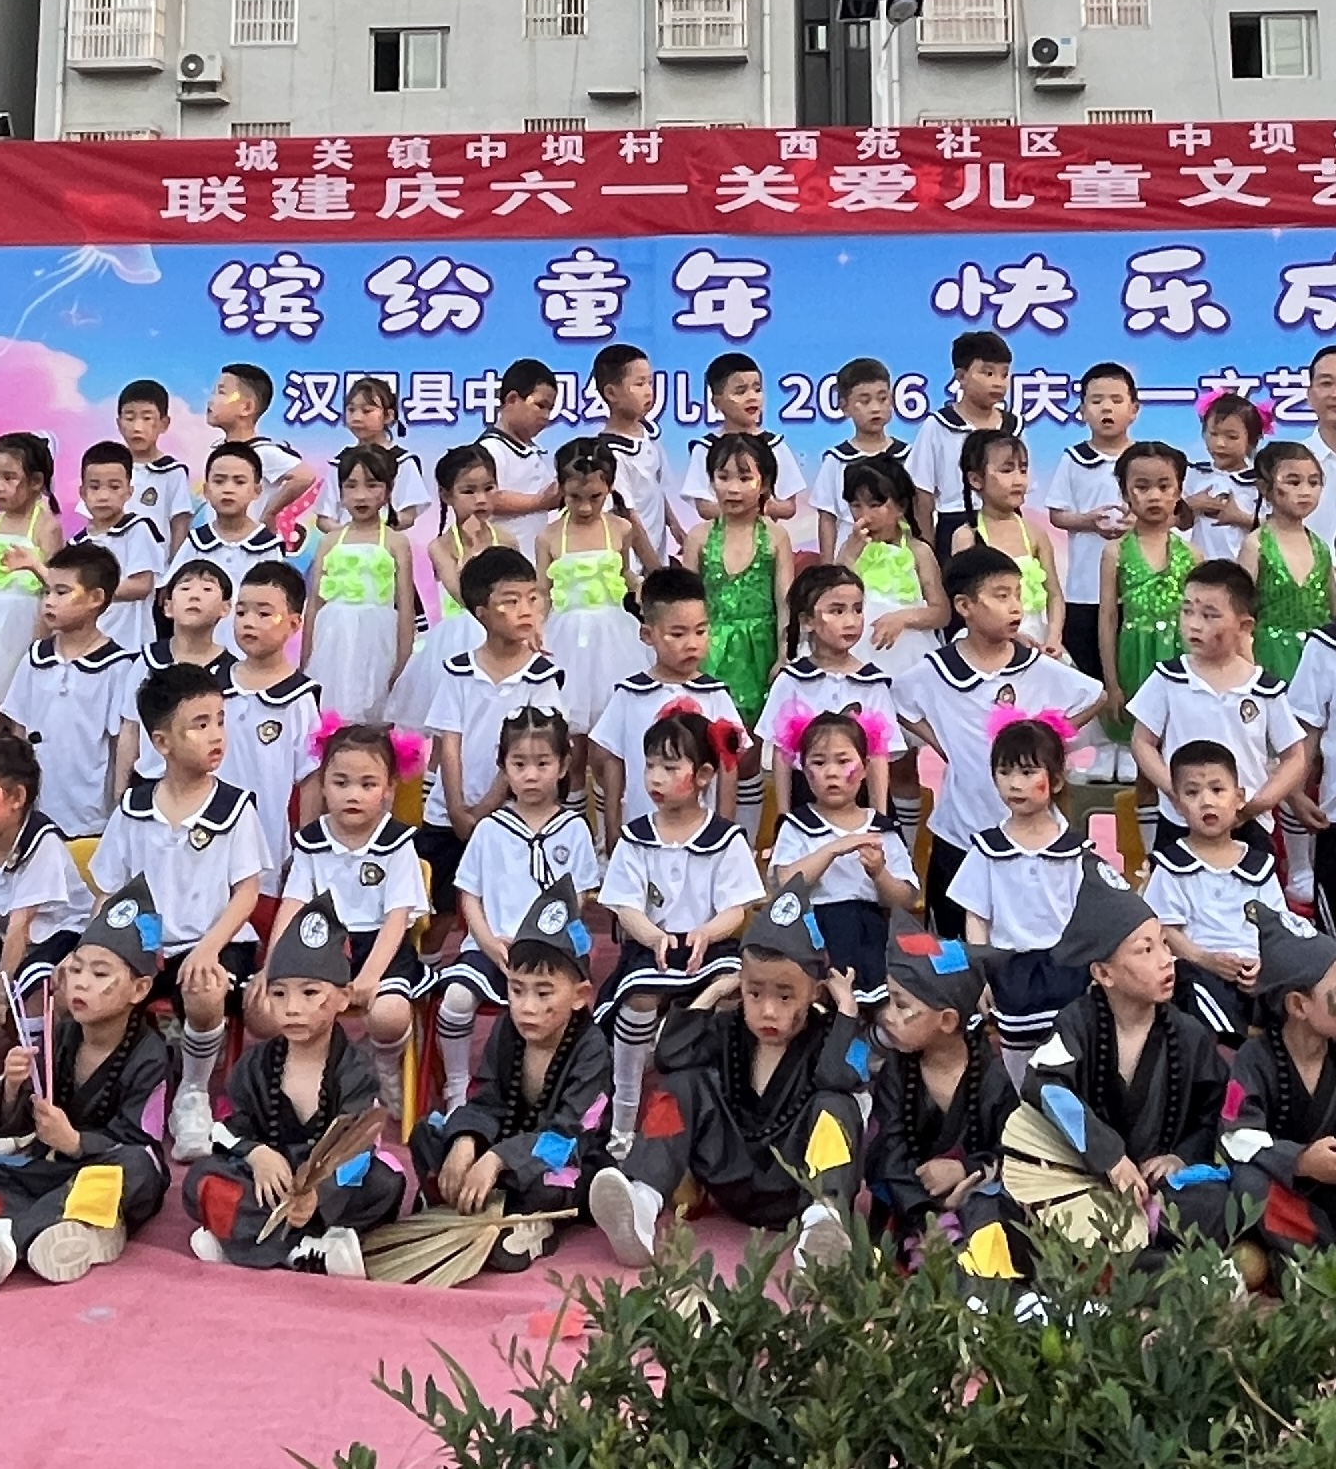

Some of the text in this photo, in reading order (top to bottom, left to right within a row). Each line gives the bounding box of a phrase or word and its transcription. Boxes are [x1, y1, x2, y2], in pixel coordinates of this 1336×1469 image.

[235, 133, 664, 171] 城关镇中坝村
[775, 126, 1062, 162] 西苑社区
[209, 249, 771, 339] 缤纷童年
